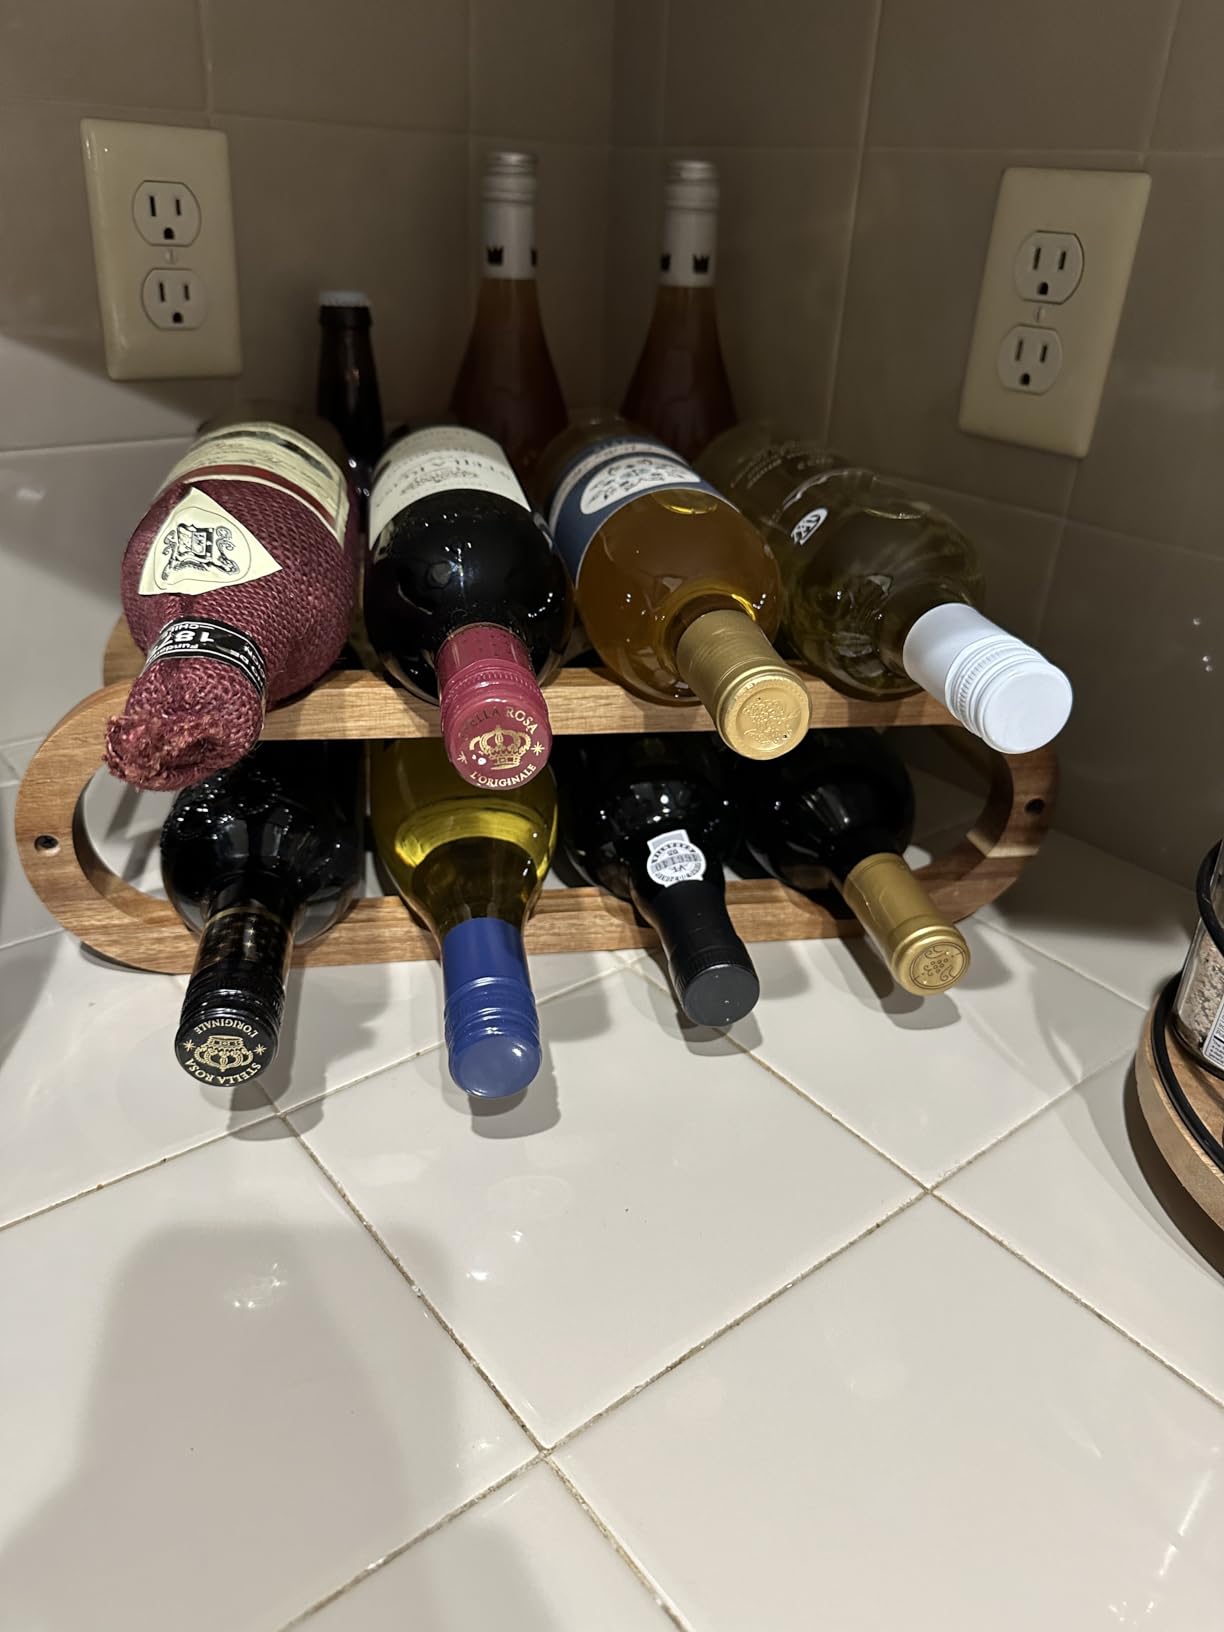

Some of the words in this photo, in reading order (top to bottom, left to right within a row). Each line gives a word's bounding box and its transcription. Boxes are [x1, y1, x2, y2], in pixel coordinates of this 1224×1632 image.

[506, 706, 539, 735] ROSA
[469, 763, 537, 788] L'ORIGINALE
[193, 1018, 259, 1038] L'ORIGINALE
[184, 1058, 216, 1082] ROSA
[218, 1062, 262, 1084] STELLA
